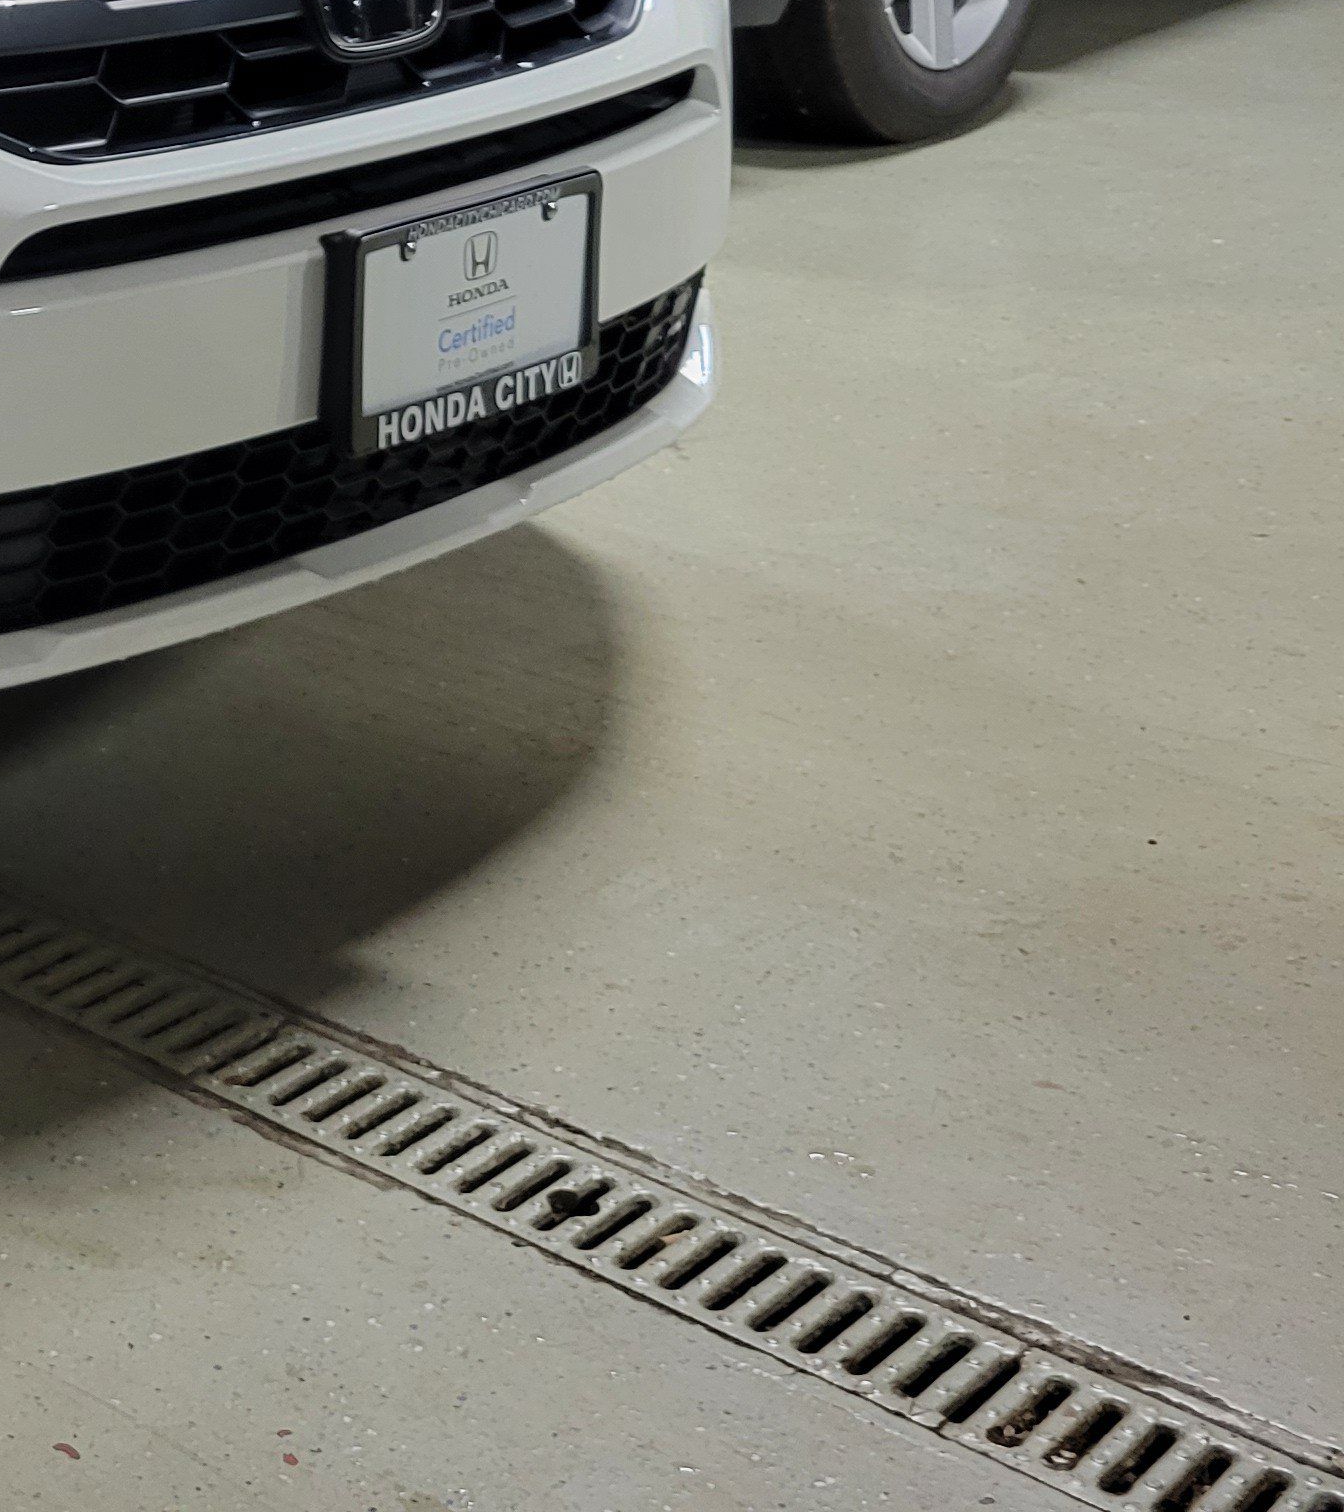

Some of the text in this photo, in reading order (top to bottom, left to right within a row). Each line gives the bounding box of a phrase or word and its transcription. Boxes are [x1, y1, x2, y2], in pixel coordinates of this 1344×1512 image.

[447, 278, 510, 307] HONDA
[438, 305, 516, 353] Certified
[377, 386, 487, 450] HONDA
[494, 354, 559, 411] CITY
